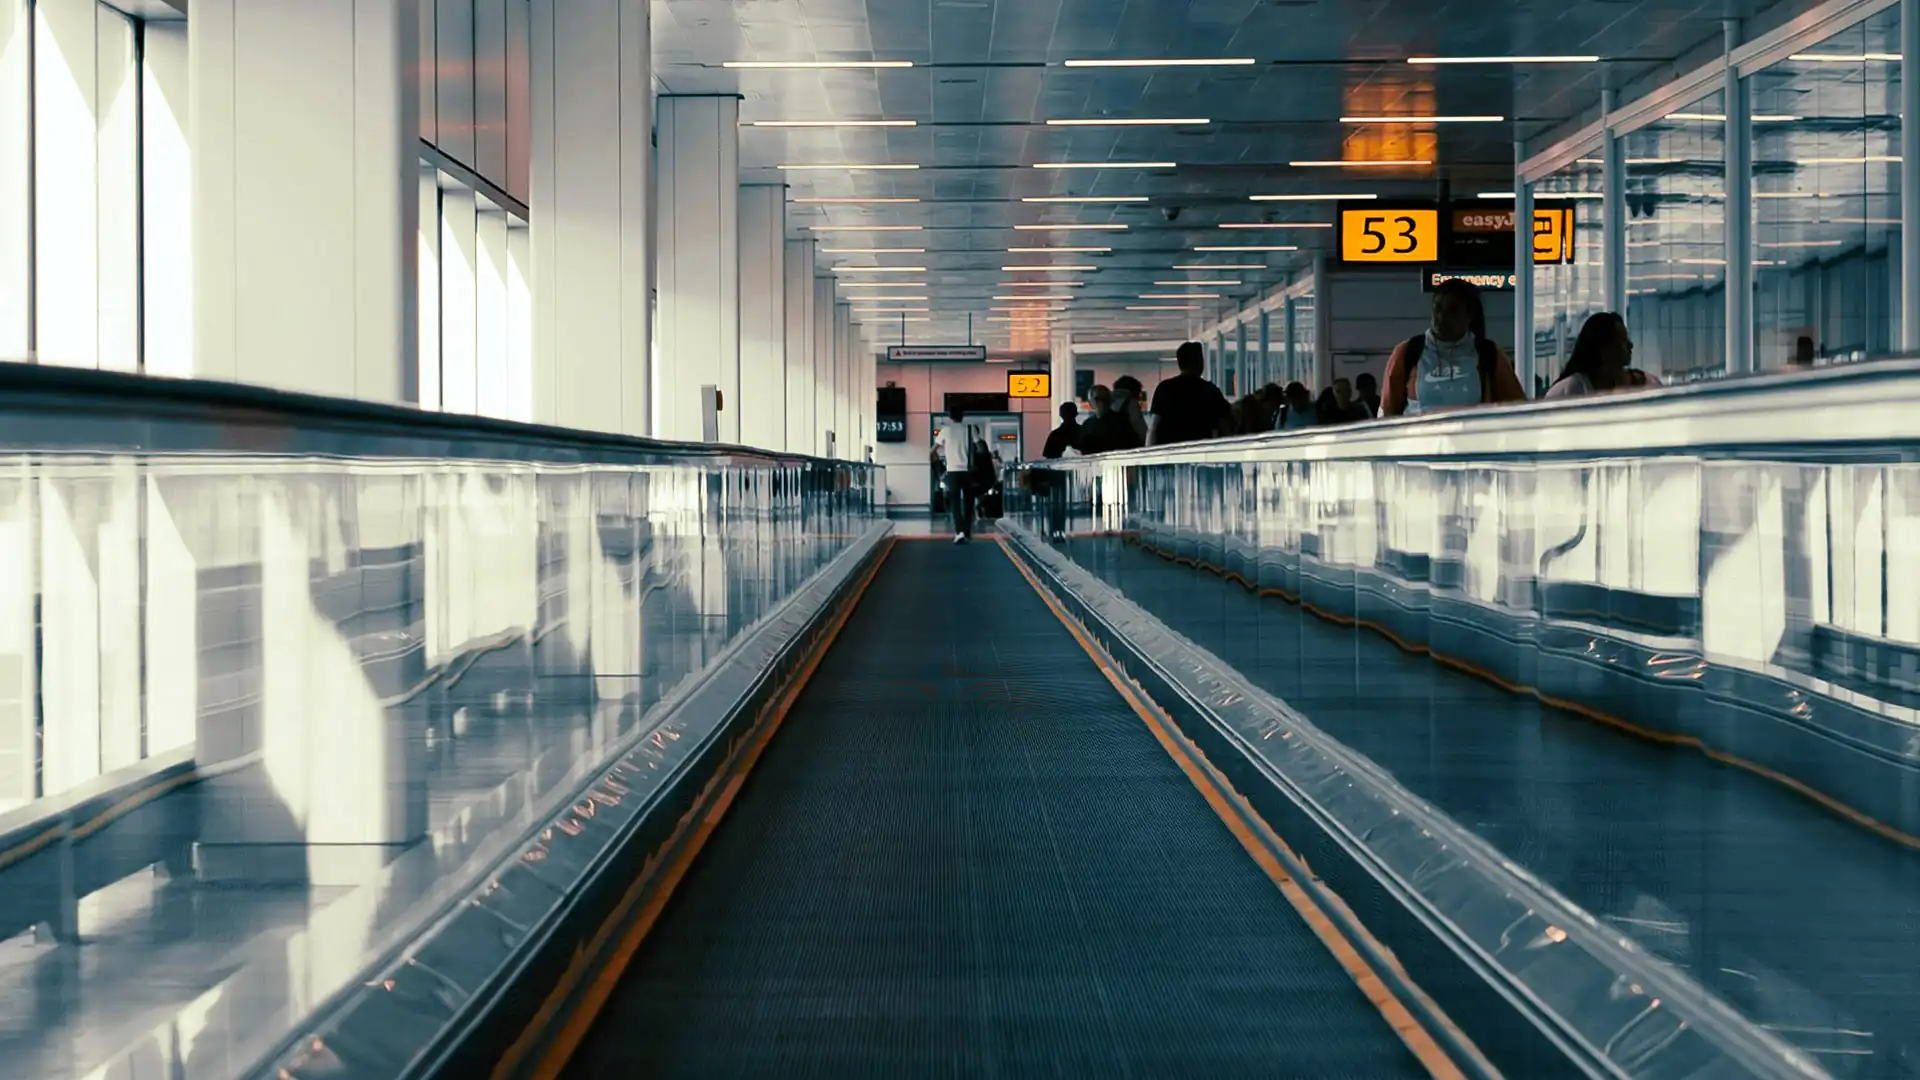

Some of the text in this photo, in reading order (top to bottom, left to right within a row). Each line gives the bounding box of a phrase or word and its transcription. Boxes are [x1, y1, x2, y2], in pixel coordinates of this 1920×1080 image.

[1462, 212, 1515, 229] easyJ
[1361, 216, 1418, 254] 53
[1017, 378, 1041, 392] 52
[877, 421, 904, 432] 17:53
